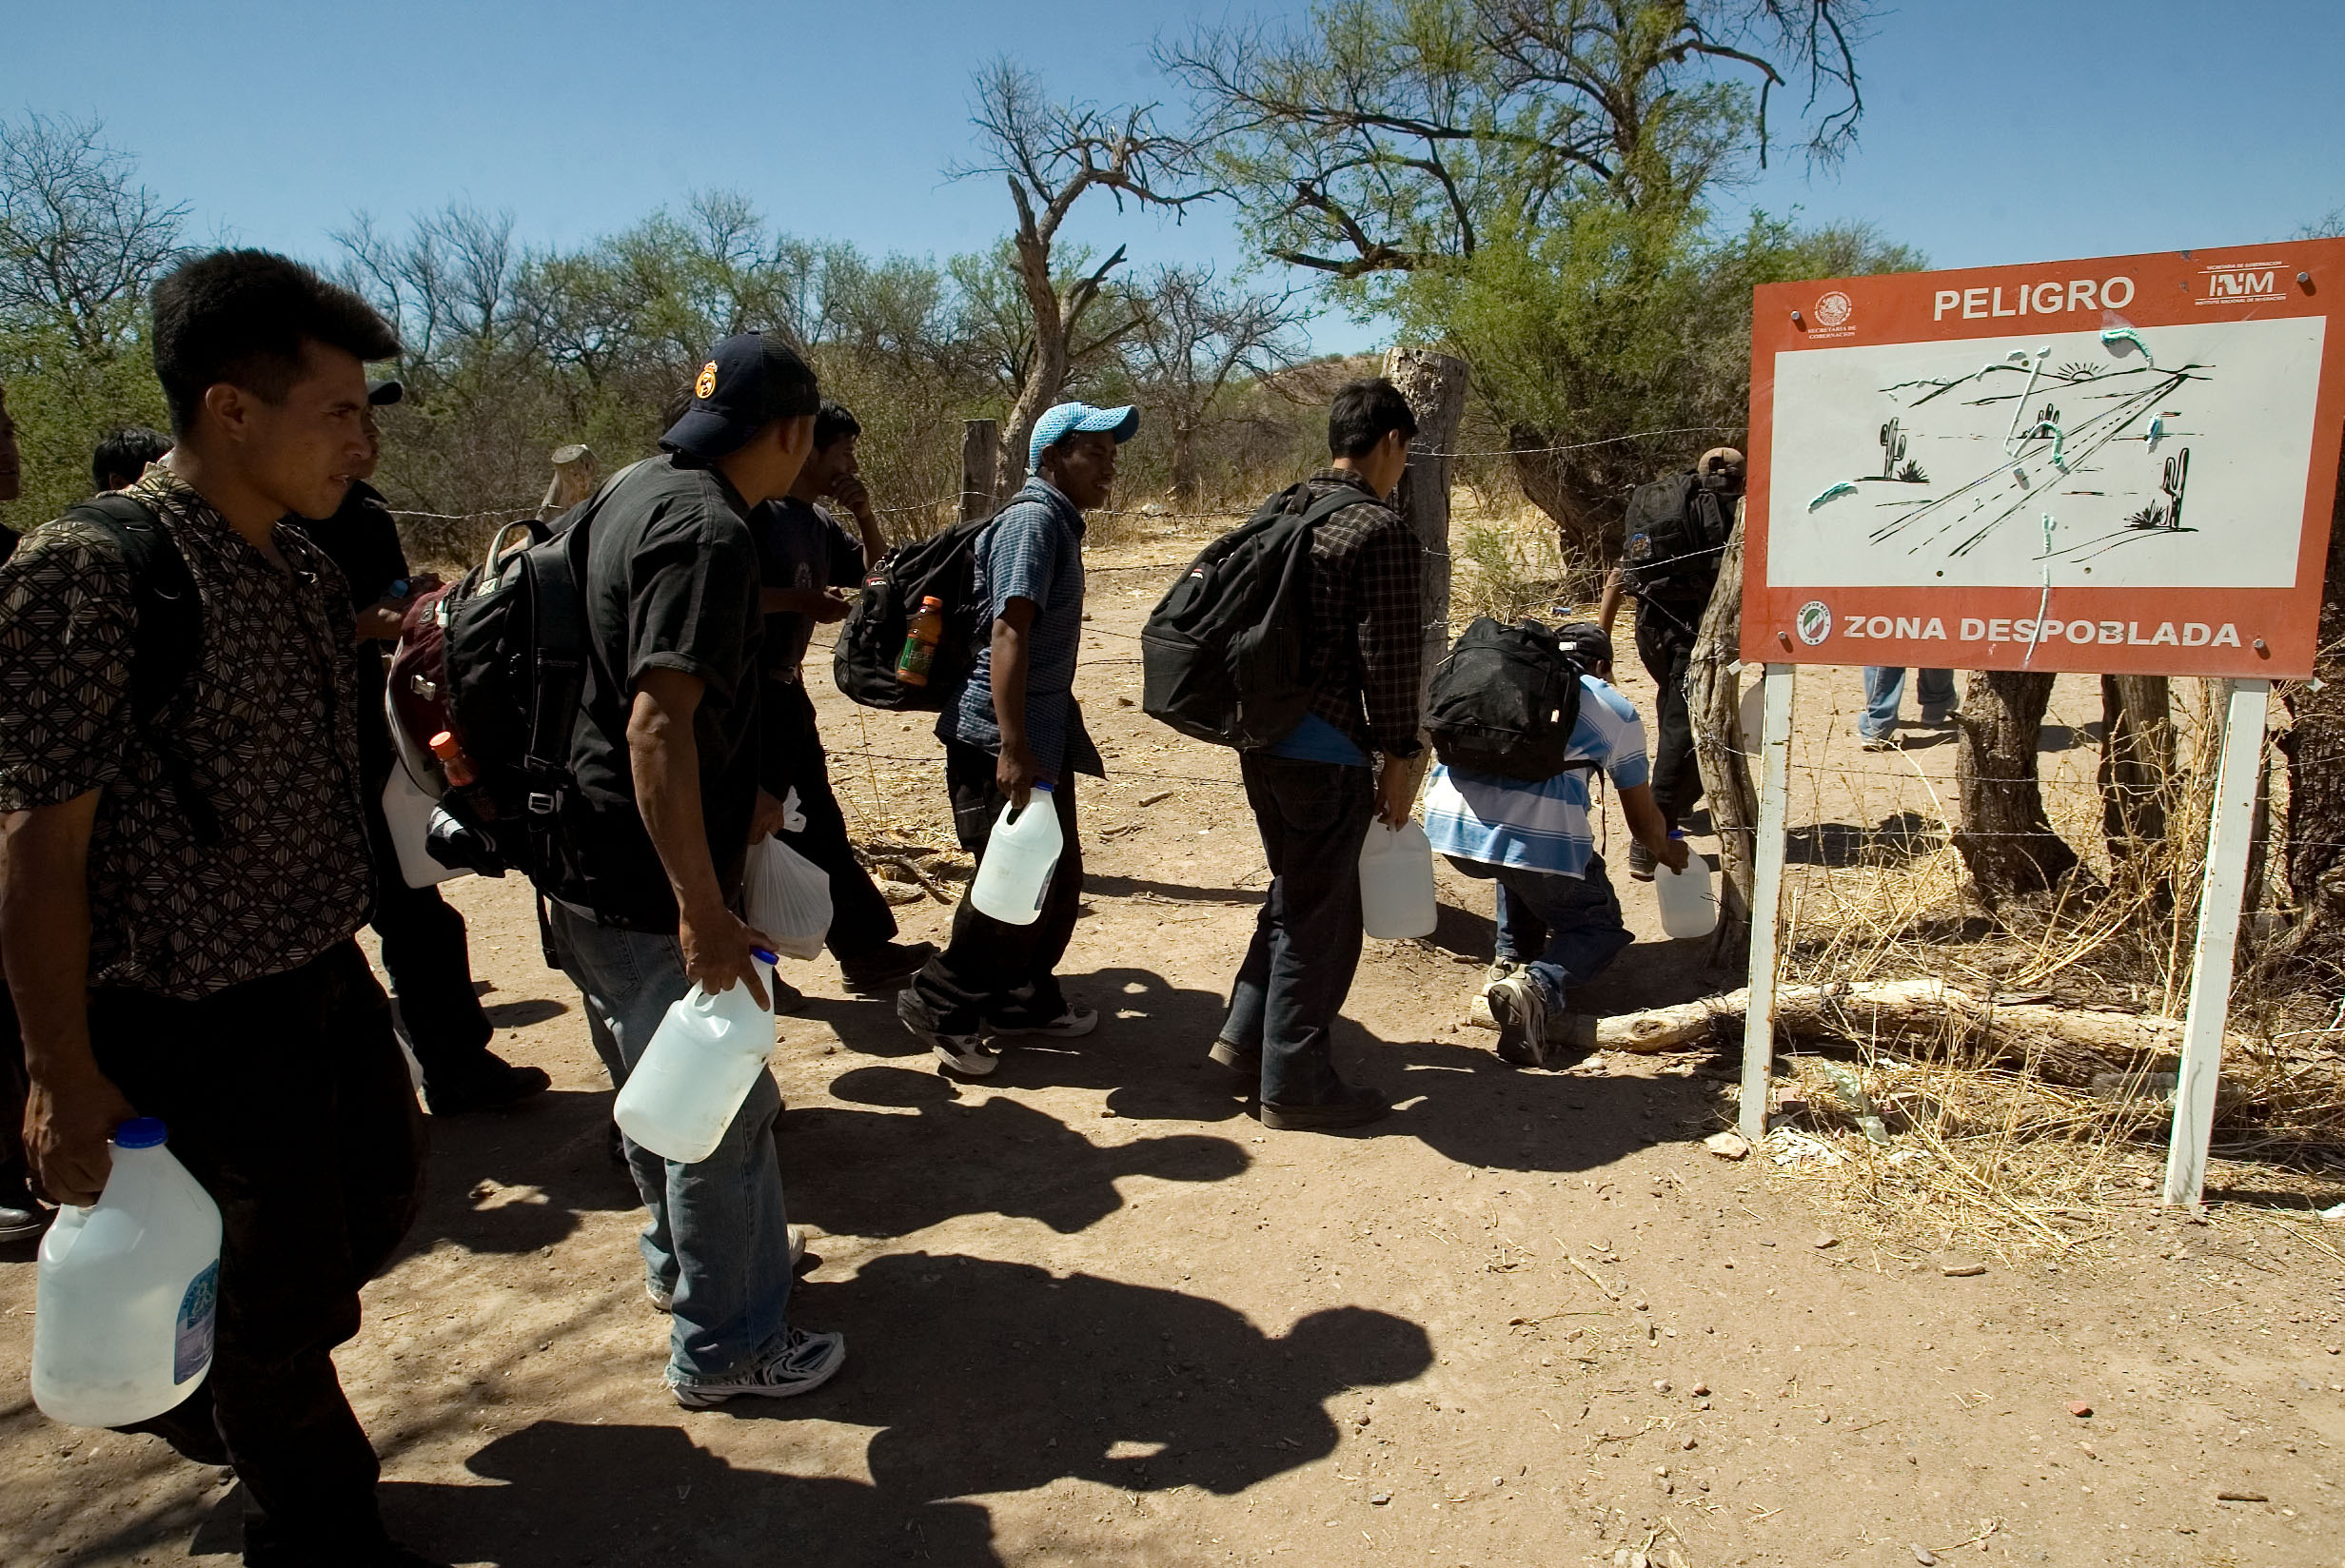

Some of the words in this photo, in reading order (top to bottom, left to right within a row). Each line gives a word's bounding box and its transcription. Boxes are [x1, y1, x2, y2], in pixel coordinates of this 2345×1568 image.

[1934, 276, 2135, 322] PELIGRO
[2209, 271, 2275, 297] INM
[1843, 616, 1947, 641] ZONA
[1960, 617, 2242, 648] DESPOBLADA
